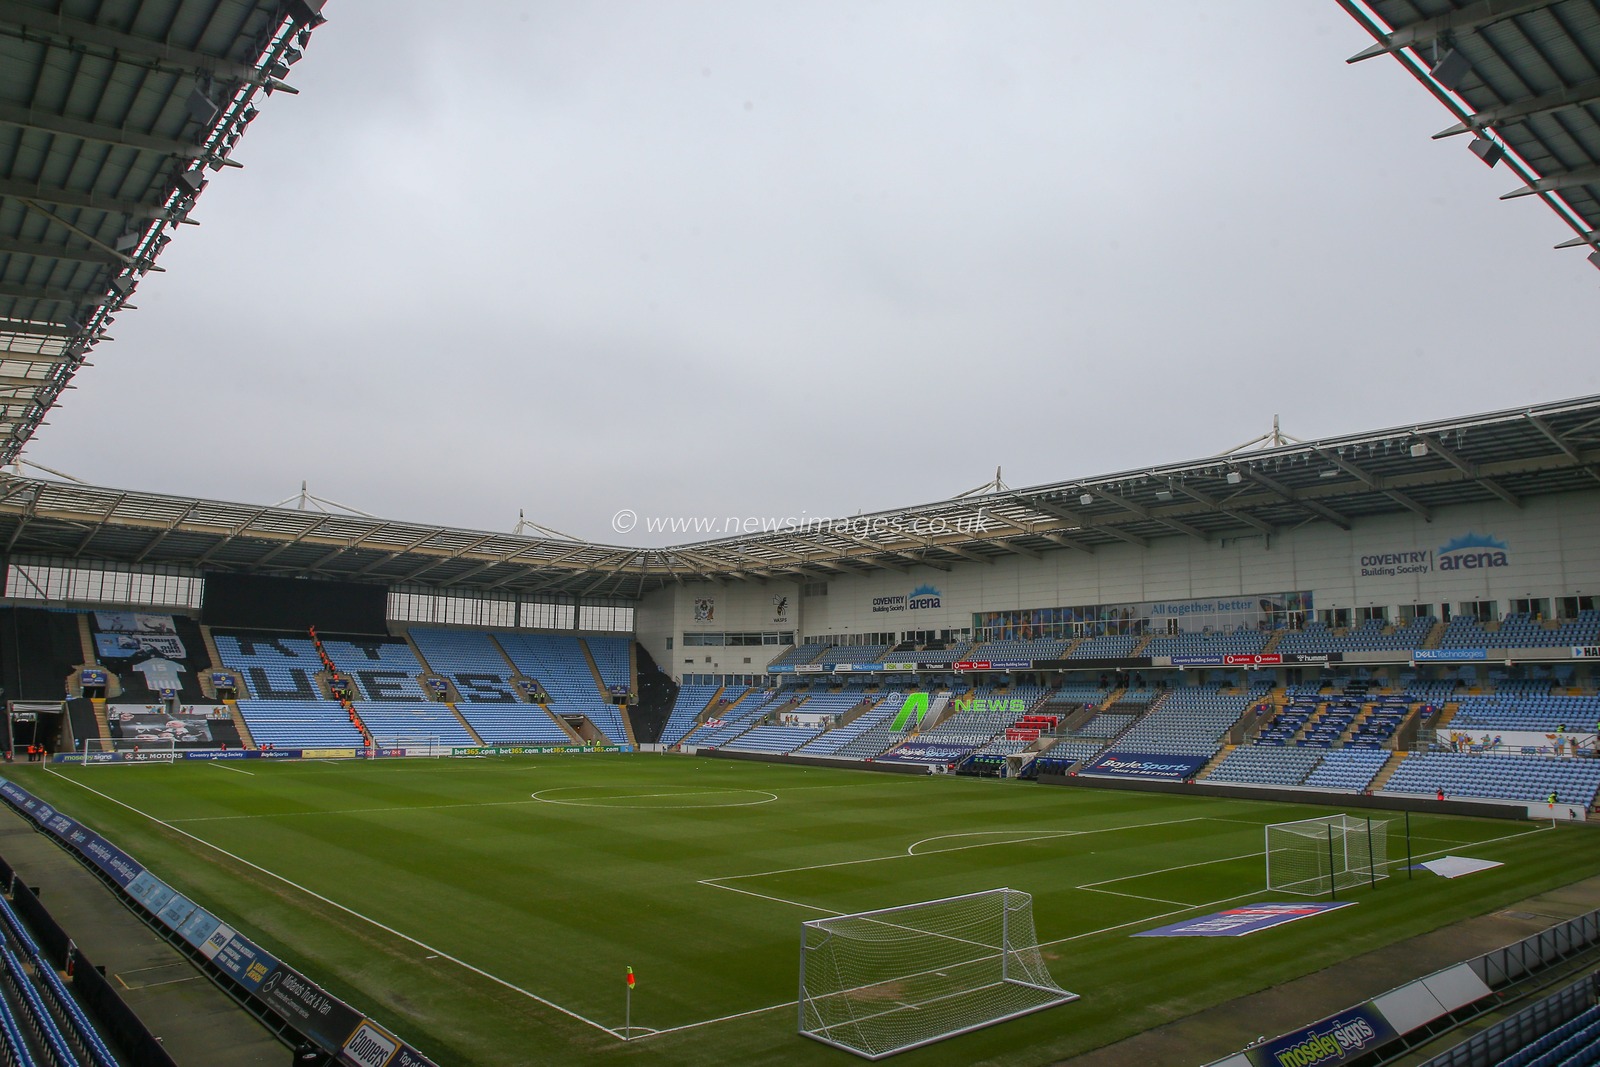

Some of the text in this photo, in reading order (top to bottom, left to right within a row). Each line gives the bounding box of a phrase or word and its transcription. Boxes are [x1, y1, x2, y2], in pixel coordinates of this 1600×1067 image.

[1361, 551, 1427, 566] COVENTRY
[1440, 552, 1509, 571] arena
[1361, 565, 1428, 577] Building Society
[873, 596, 904, 605] COVENTRY
[909, 597, 941, 610] arena
[1152, 600, 1252, 615] All together, better
[1437, 651, 1484, 659] Technologies
[1100, 759, 1191, 771] BoyleSports
[348, 1028, 389, 1067] Coopers
